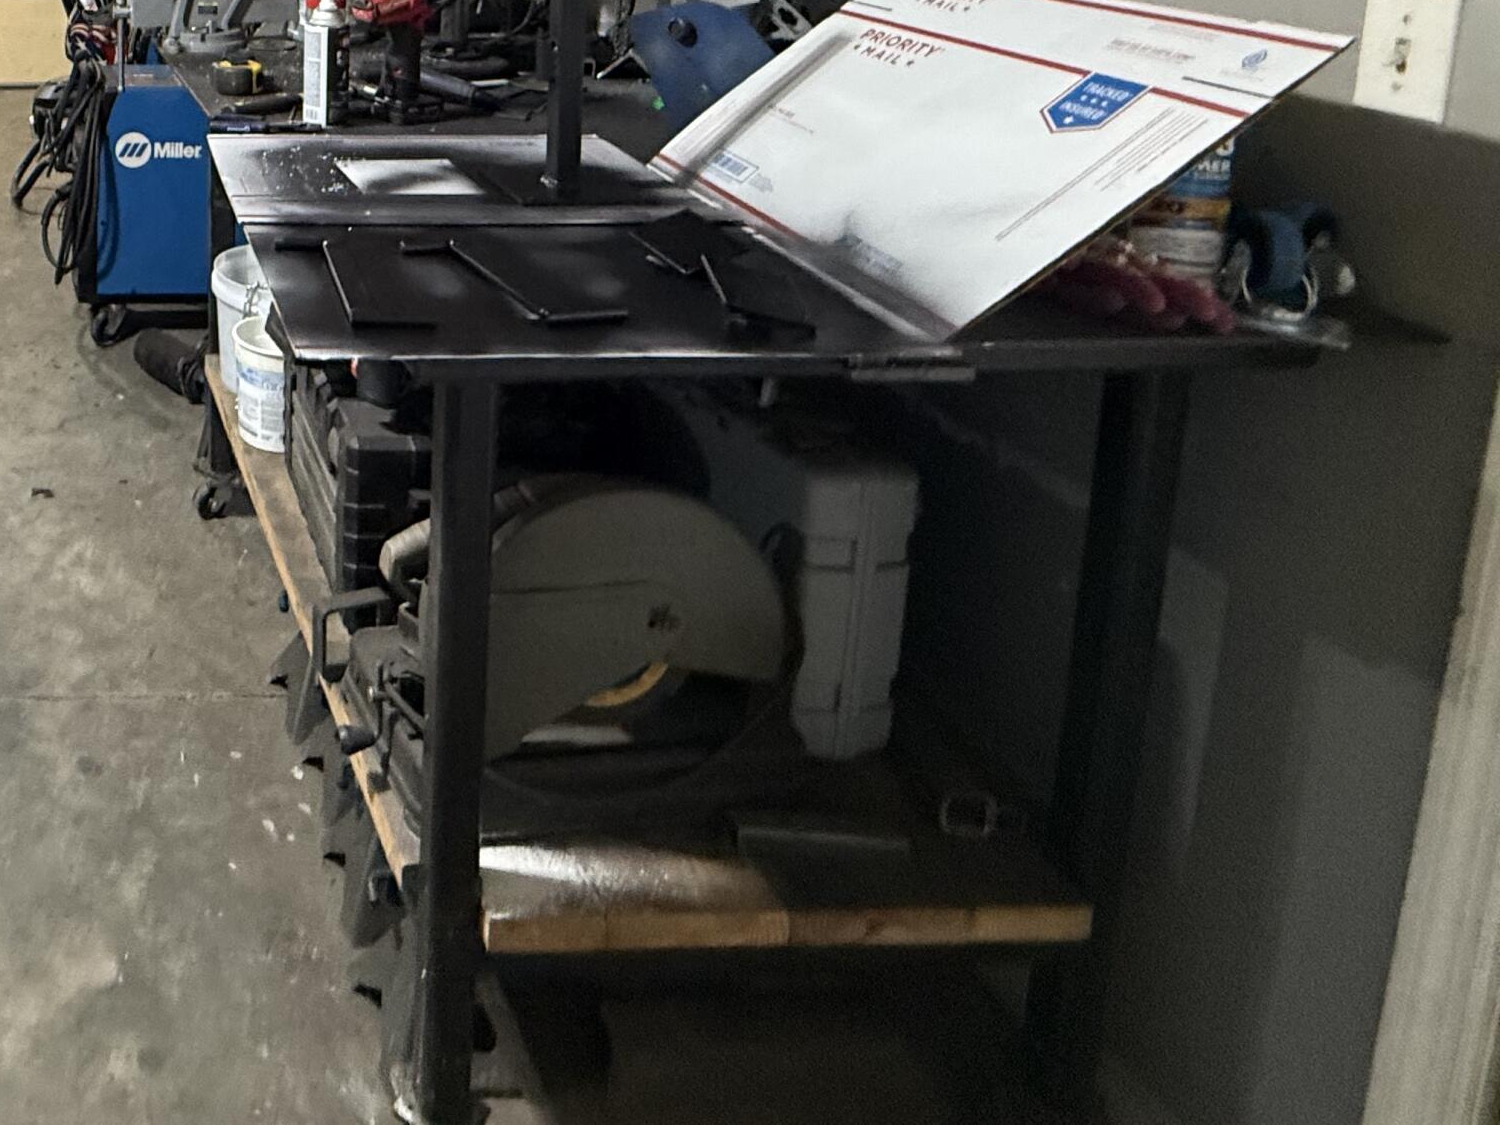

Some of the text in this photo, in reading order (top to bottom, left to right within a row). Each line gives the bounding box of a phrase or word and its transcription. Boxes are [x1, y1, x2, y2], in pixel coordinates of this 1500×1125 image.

[860, 28, 941, 57] PRIORITY
[861, 47, 902, 66] MAIL
[1082, 82, 1132, 102] TRACKED
[1058, 101, 1108, 121] INSURED
[153, 141, 203, 160] Miller
